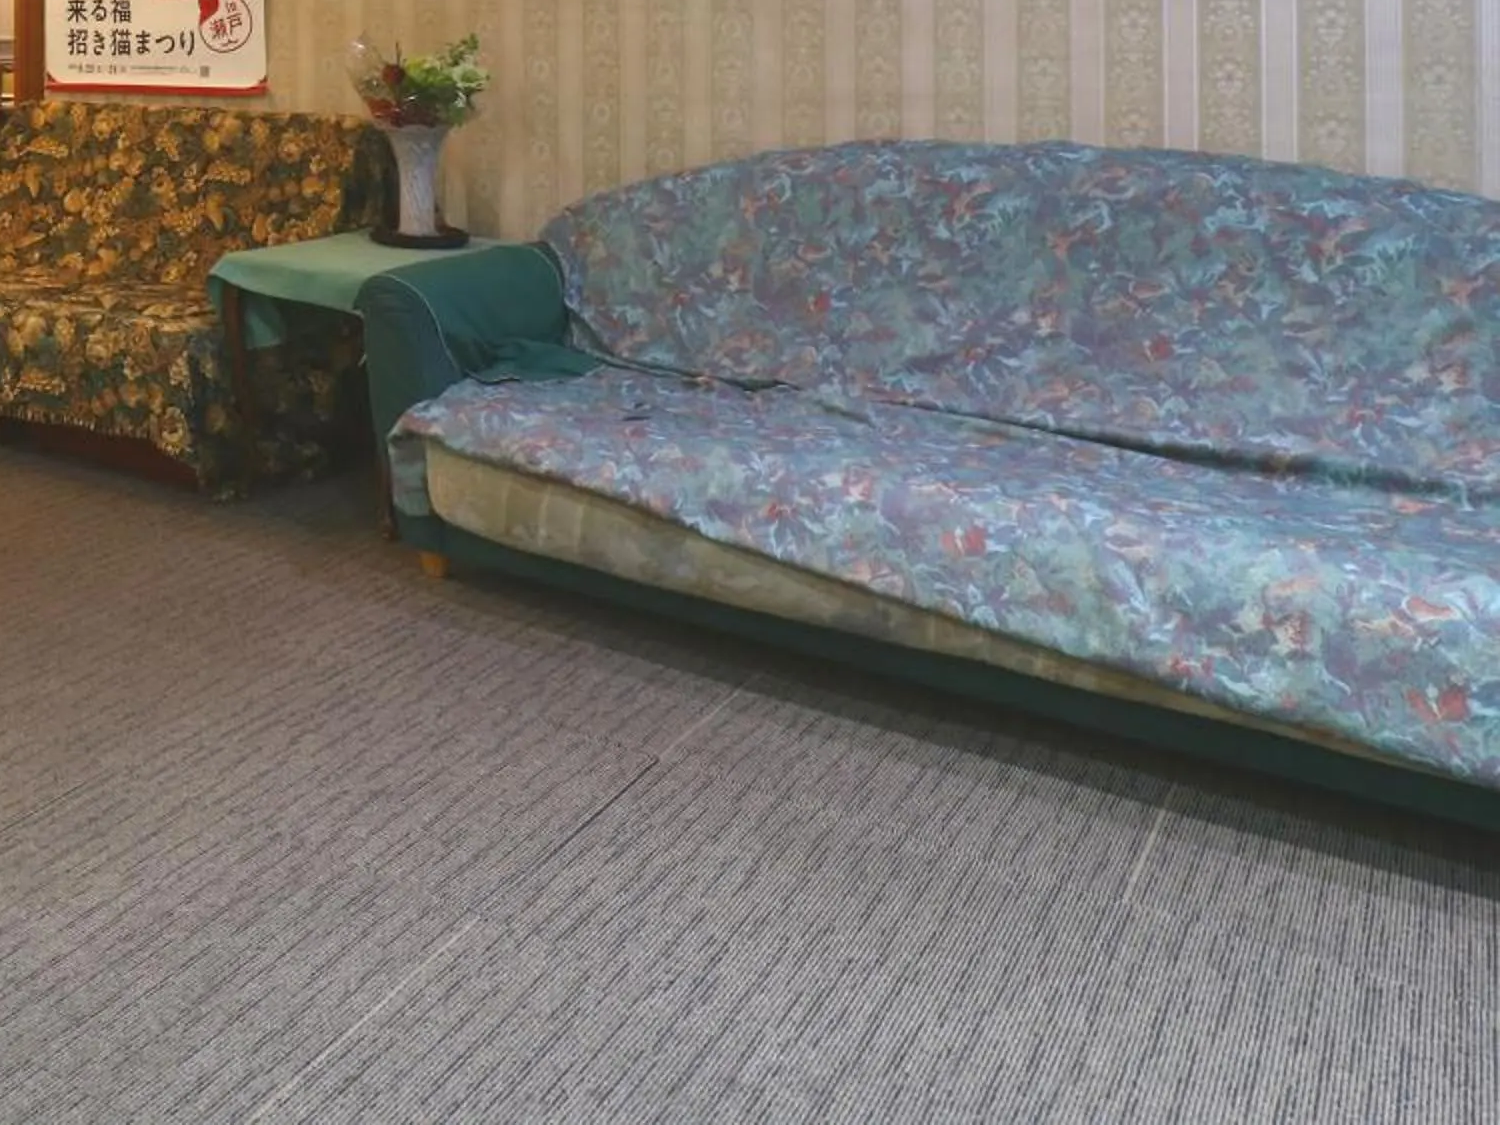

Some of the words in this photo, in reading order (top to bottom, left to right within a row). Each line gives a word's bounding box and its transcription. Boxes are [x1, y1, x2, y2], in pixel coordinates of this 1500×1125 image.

[68, 28, 195, 56] 招き猫まつり
